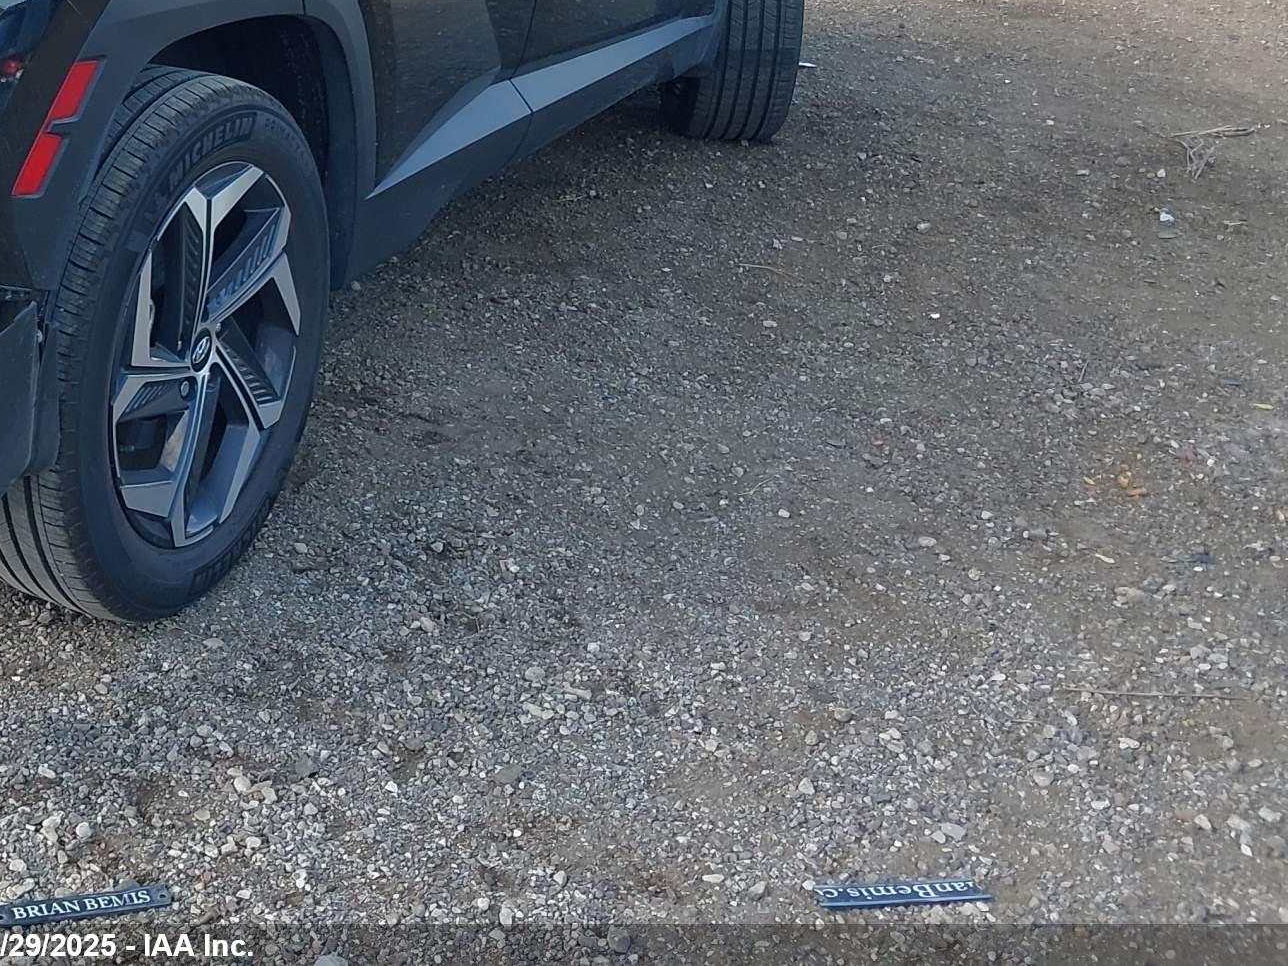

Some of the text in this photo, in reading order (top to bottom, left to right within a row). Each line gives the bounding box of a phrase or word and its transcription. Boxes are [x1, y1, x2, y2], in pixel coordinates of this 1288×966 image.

[168, 116, 254, 191] MICHELIN
[12, 889, 151, 921] BRIAN BEMIS
